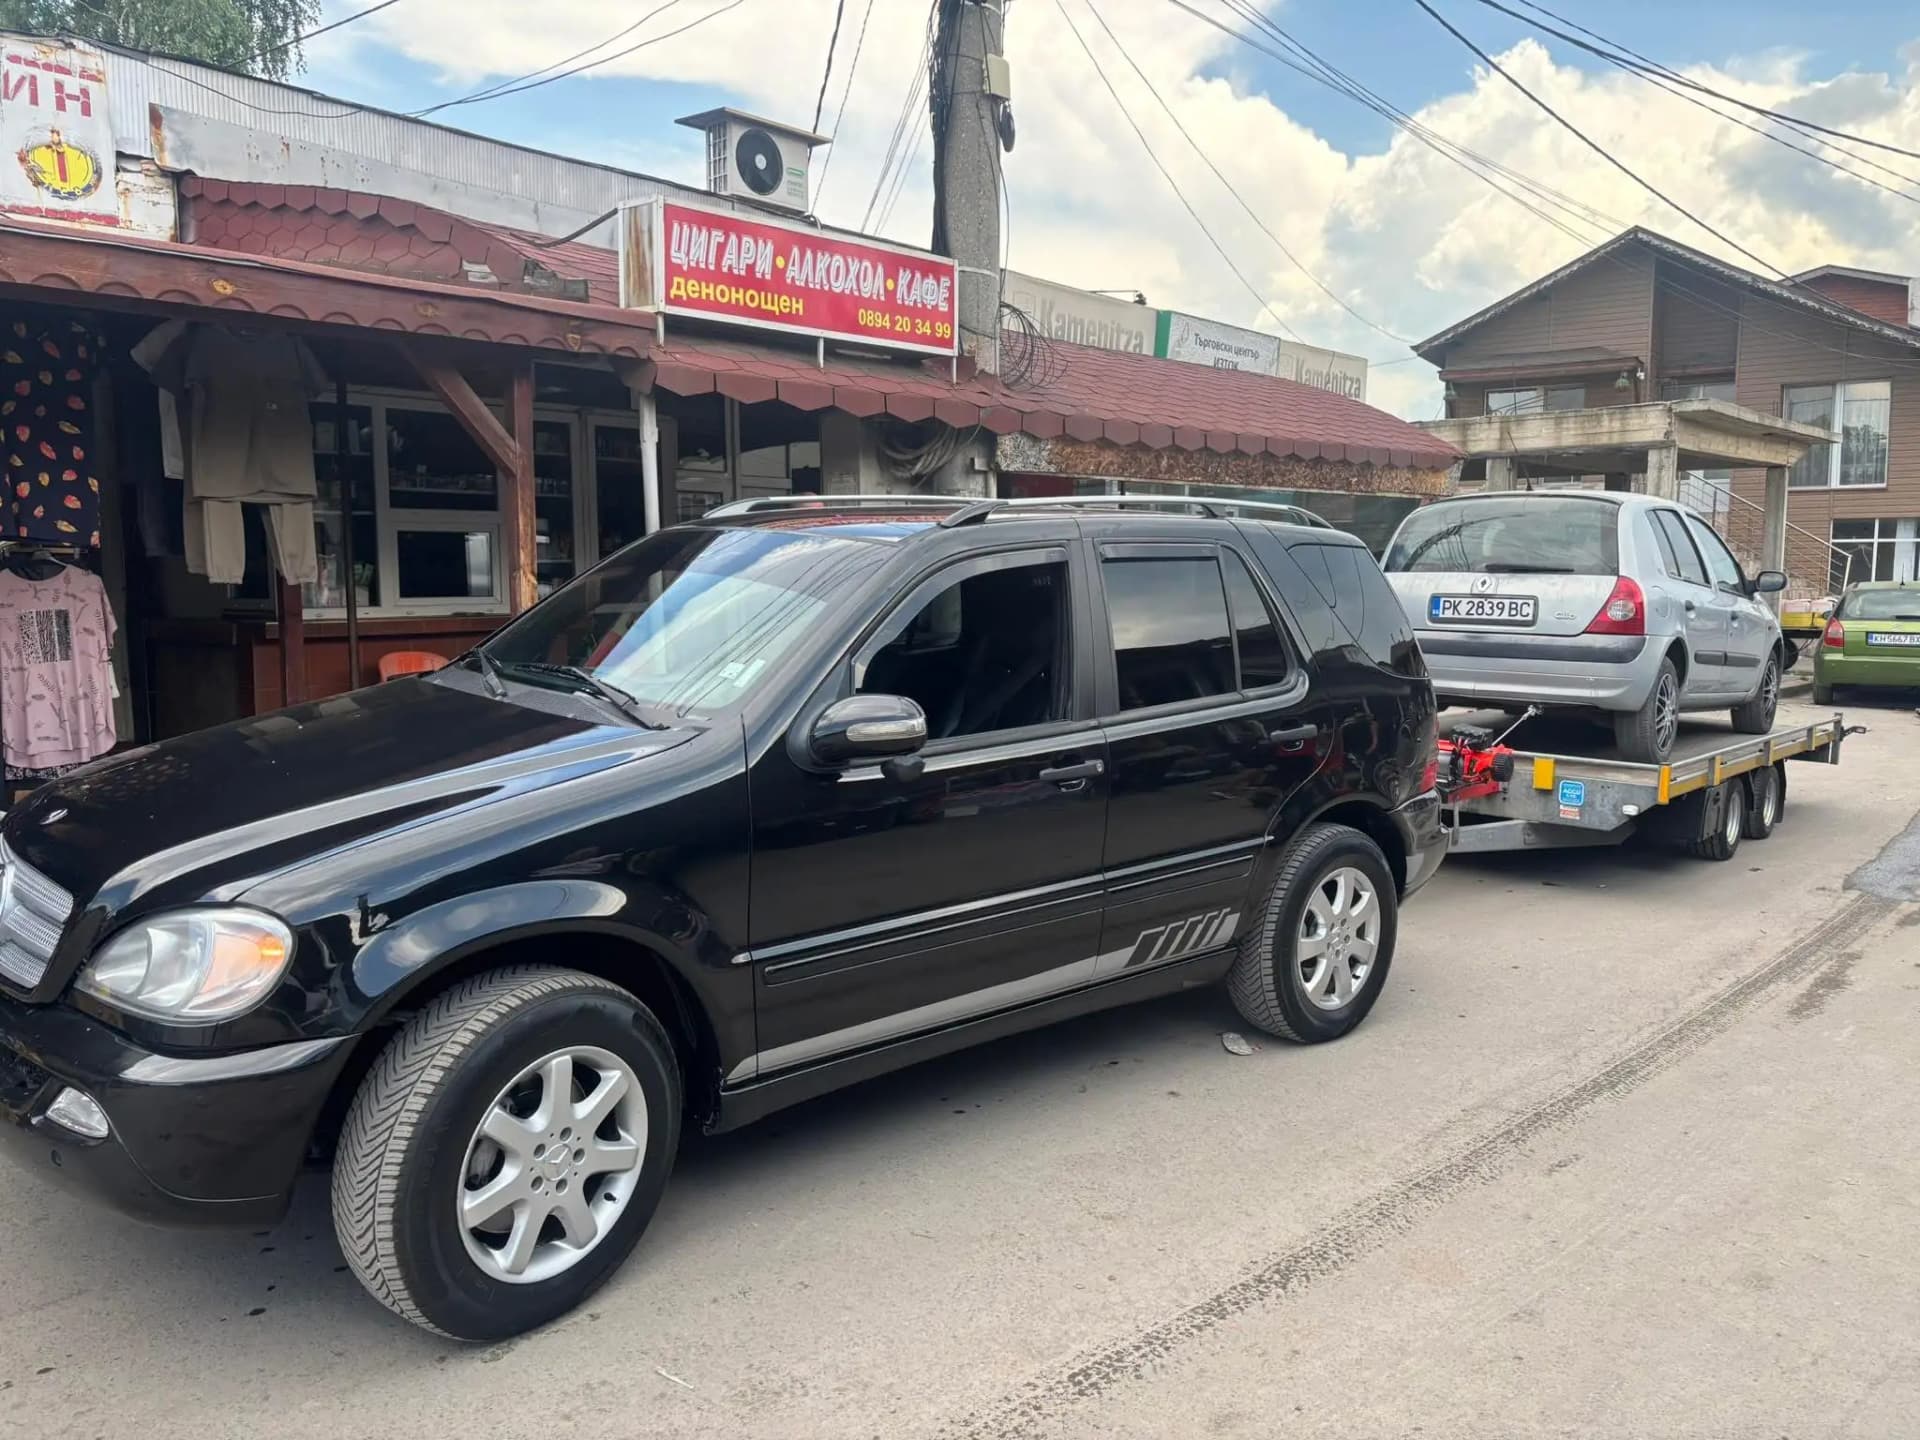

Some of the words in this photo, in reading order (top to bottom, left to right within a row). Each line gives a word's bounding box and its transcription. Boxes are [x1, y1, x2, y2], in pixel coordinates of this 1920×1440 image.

[670, 220, 774, 281] ЦИГАРИ
[785, 245, 886, 302] АЛКОХОЛ
[896, 267, 951, 312] КАФЕ
[670, 275, 805, 316] денонощен
[858, 308, 891, 330] 0894
[895, 317, 911, 333] 20
[914, 319, 932, 336] 34
[935, 322, 952, 339] 99
[1040, 295, 1144, 352] Kamenitza
[1194, 332, 1233, 355] Търговски
[1234, 344, 1260, 360] център
[1442, 599, 1463, 616] PK
[1465, 600, 1505, 617] 2839
[1508, 602, 1531, 618] BC
